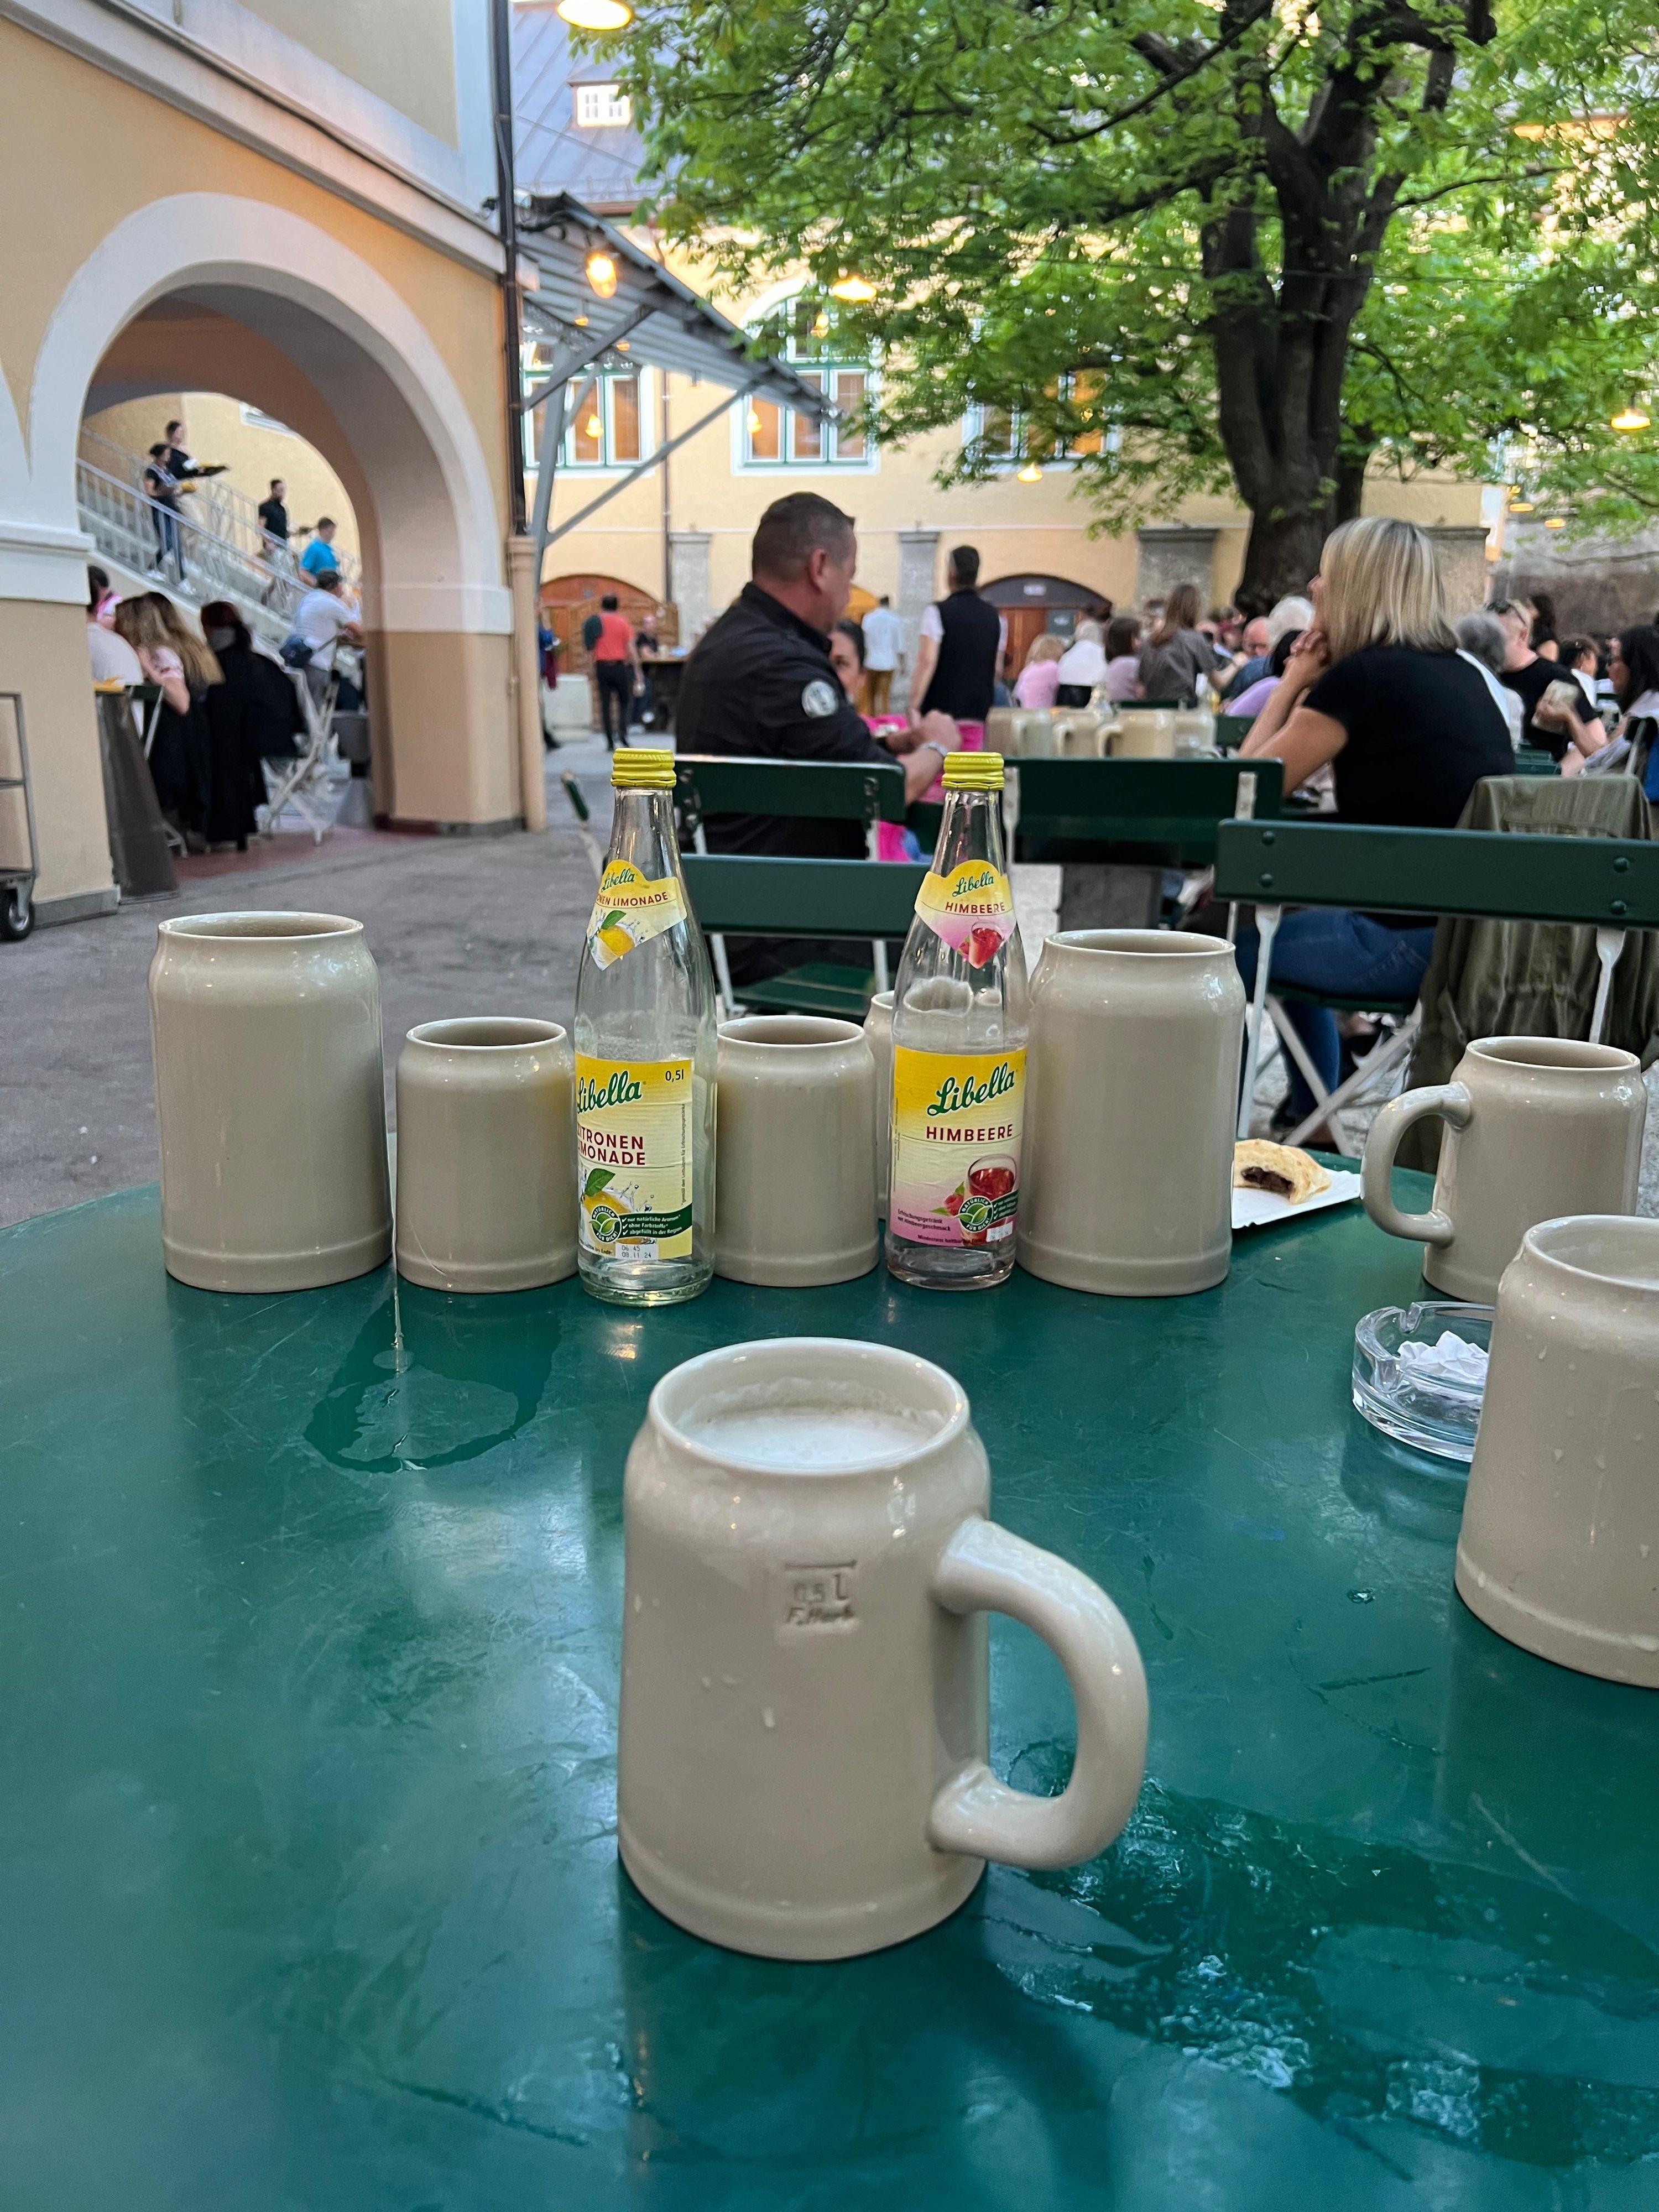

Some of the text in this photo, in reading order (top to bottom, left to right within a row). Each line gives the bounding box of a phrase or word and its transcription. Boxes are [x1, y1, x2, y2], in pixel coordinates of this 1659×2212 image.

[601, 868, 635, 893] Libella
[952, 871, 994, 897] Libella
[613, 892, 668, 906] LIMONADE
[945, 902, 1005, 913] HIMBEERE
[577, 1071, 641, 1114] Libella
[927, 1062, 1014, 1116] Libella
[926, 1124, 1013, 1141] HIMBEERE
